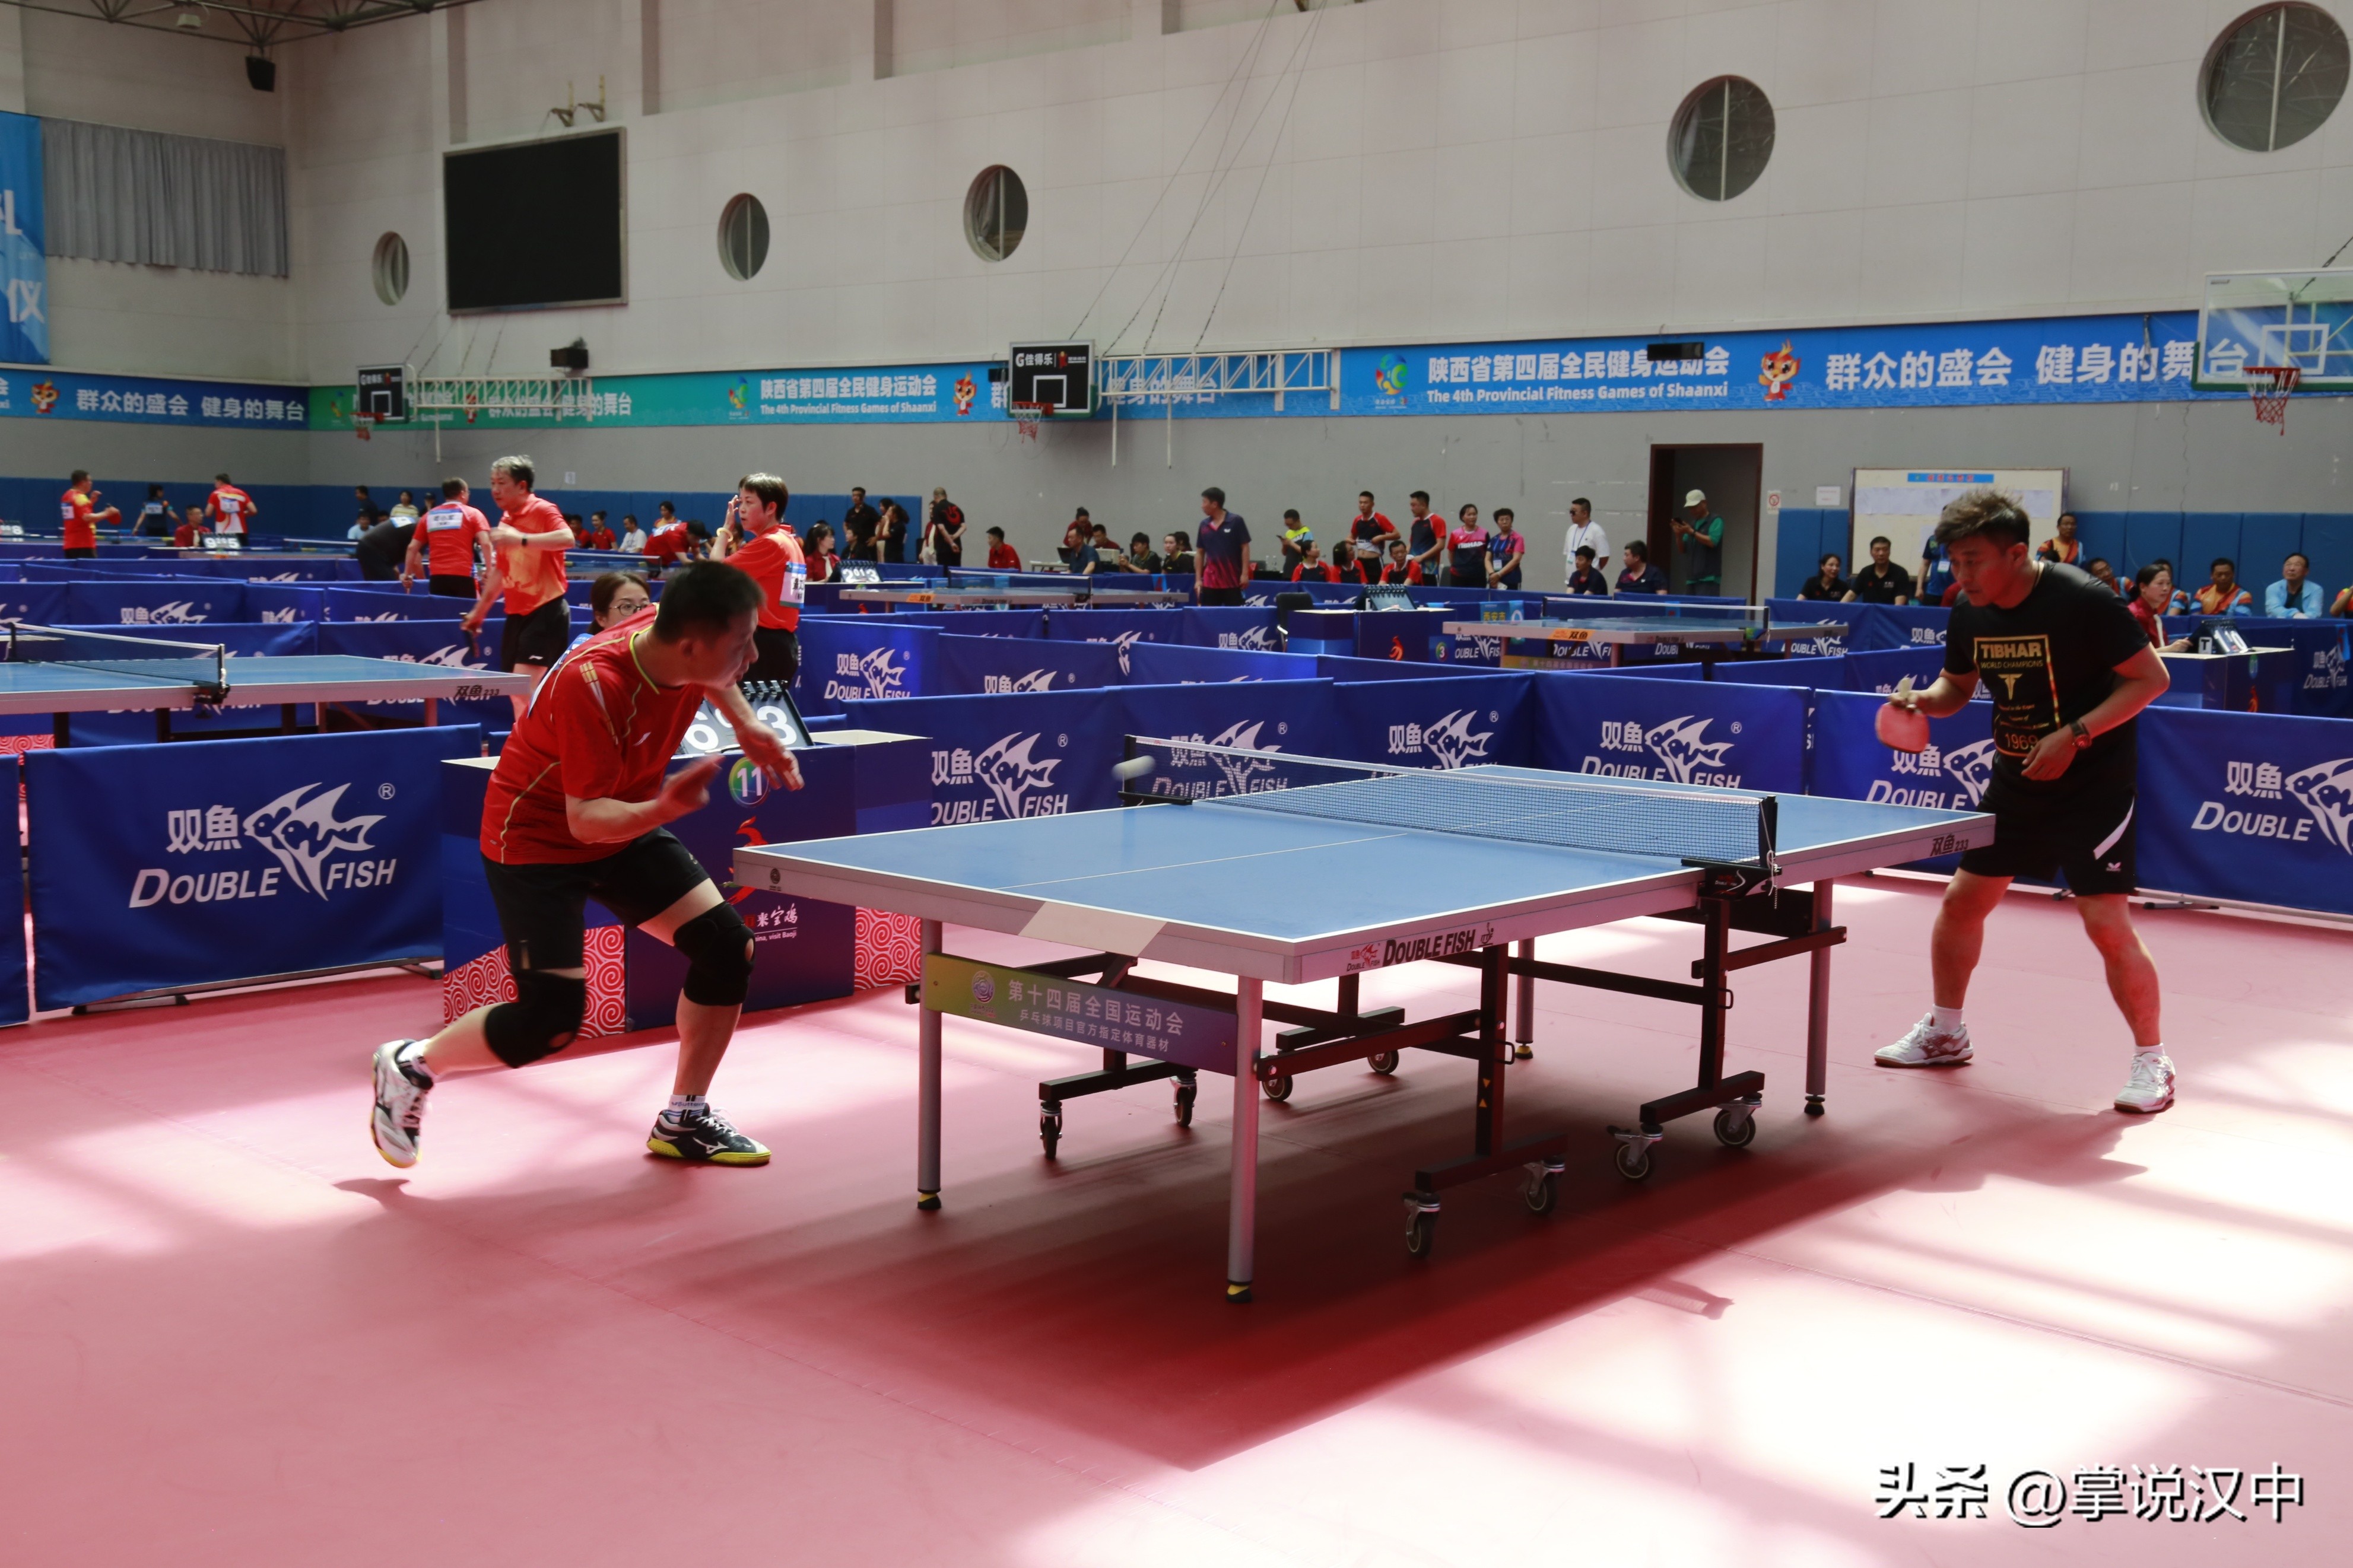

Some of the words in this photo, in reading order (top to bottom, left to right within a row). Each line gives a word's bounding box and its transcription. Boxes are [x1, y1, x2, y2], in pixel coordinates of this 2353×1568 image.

[1428, 345, 1730, 383] 陕西省第四届全民健身运动会
[1825, 347, 2014, 391] 群众的盛会
[2035, 338, 2249, 385] 健身的舞台
[761, 374, 936, 400] 陕西省第四届全民健身运动会
[1427, 390, 1450, 403] The
[1452, 389, 1474, 402] 4th
[1477, 386, 1544, 402] Provincial
[1547, 384, 1594, 400] Fitness
[1598, 385, 1646, 399] Games
[1649, 383, 1664, 397] of
[1666, 381, 1728, 397] Shaanxi
[76, 389, 189, 416] 群众的盛会
[201, 396, 304, 422] 健身的舞台
[760, 404, 774, 415] The
[776, 403, 789, 414] 4th
[790, 402, 830, 415] Provincial
[831, 402, 859, 414] Fitness
[861, 401, 888, 414] Games
[891, 402, 900, 413] of
[901, 400, 936, 413] Shaanxi
[1455, 647, 1479, 659] OUBLE
[1489, 647, 1500, 657] FIS
[1781, 643, 1817, 654] OUBLE
[1980, 642, 2042, 659] TIBHAR
[2201, 639, 2210, 650] T
[2003, 660, 2043, 668] CHAMPIONS
[456, 685, 482, 698] 双鱼
[824, 680, 872, 699] DOUBLE
[757, 705, 796, 746] 3
[737, 766, 762, 797] 11
[1580, 755, 1666, 782] DOUBLE
[1693, 772, 1741, 788] FISH
[1151, 777, 1228, 799] DOUBLE
[1249, 777, 1288, 794] FISH
[1866, 780, 1968, 810] DOUBLE
[931, 798, 996, 825] OUBLE
[1023, 794, 1068, 818] FISH
[2190, 801, 2314, 841] DOUBLE
[1930, 834, 1954, 857] 双鱼
[1955, 838, 1969, 852] 233
[129, 867, 282, 908] DOUBLE
[326, 858, 397, 891] FISH
[782, 930, 797, 939] Baoji
[1382, 934, 1442, 967] DOUBLE
[1444, 928, 1476, 954] FISH
[1347, 961, 1366, 972] DOUBLE
[1008, 978, 1185, 1036] 第十四届全国运动会
[1019, 1008, 1170, 1053] 乒乓球项目官方指定体育器材
